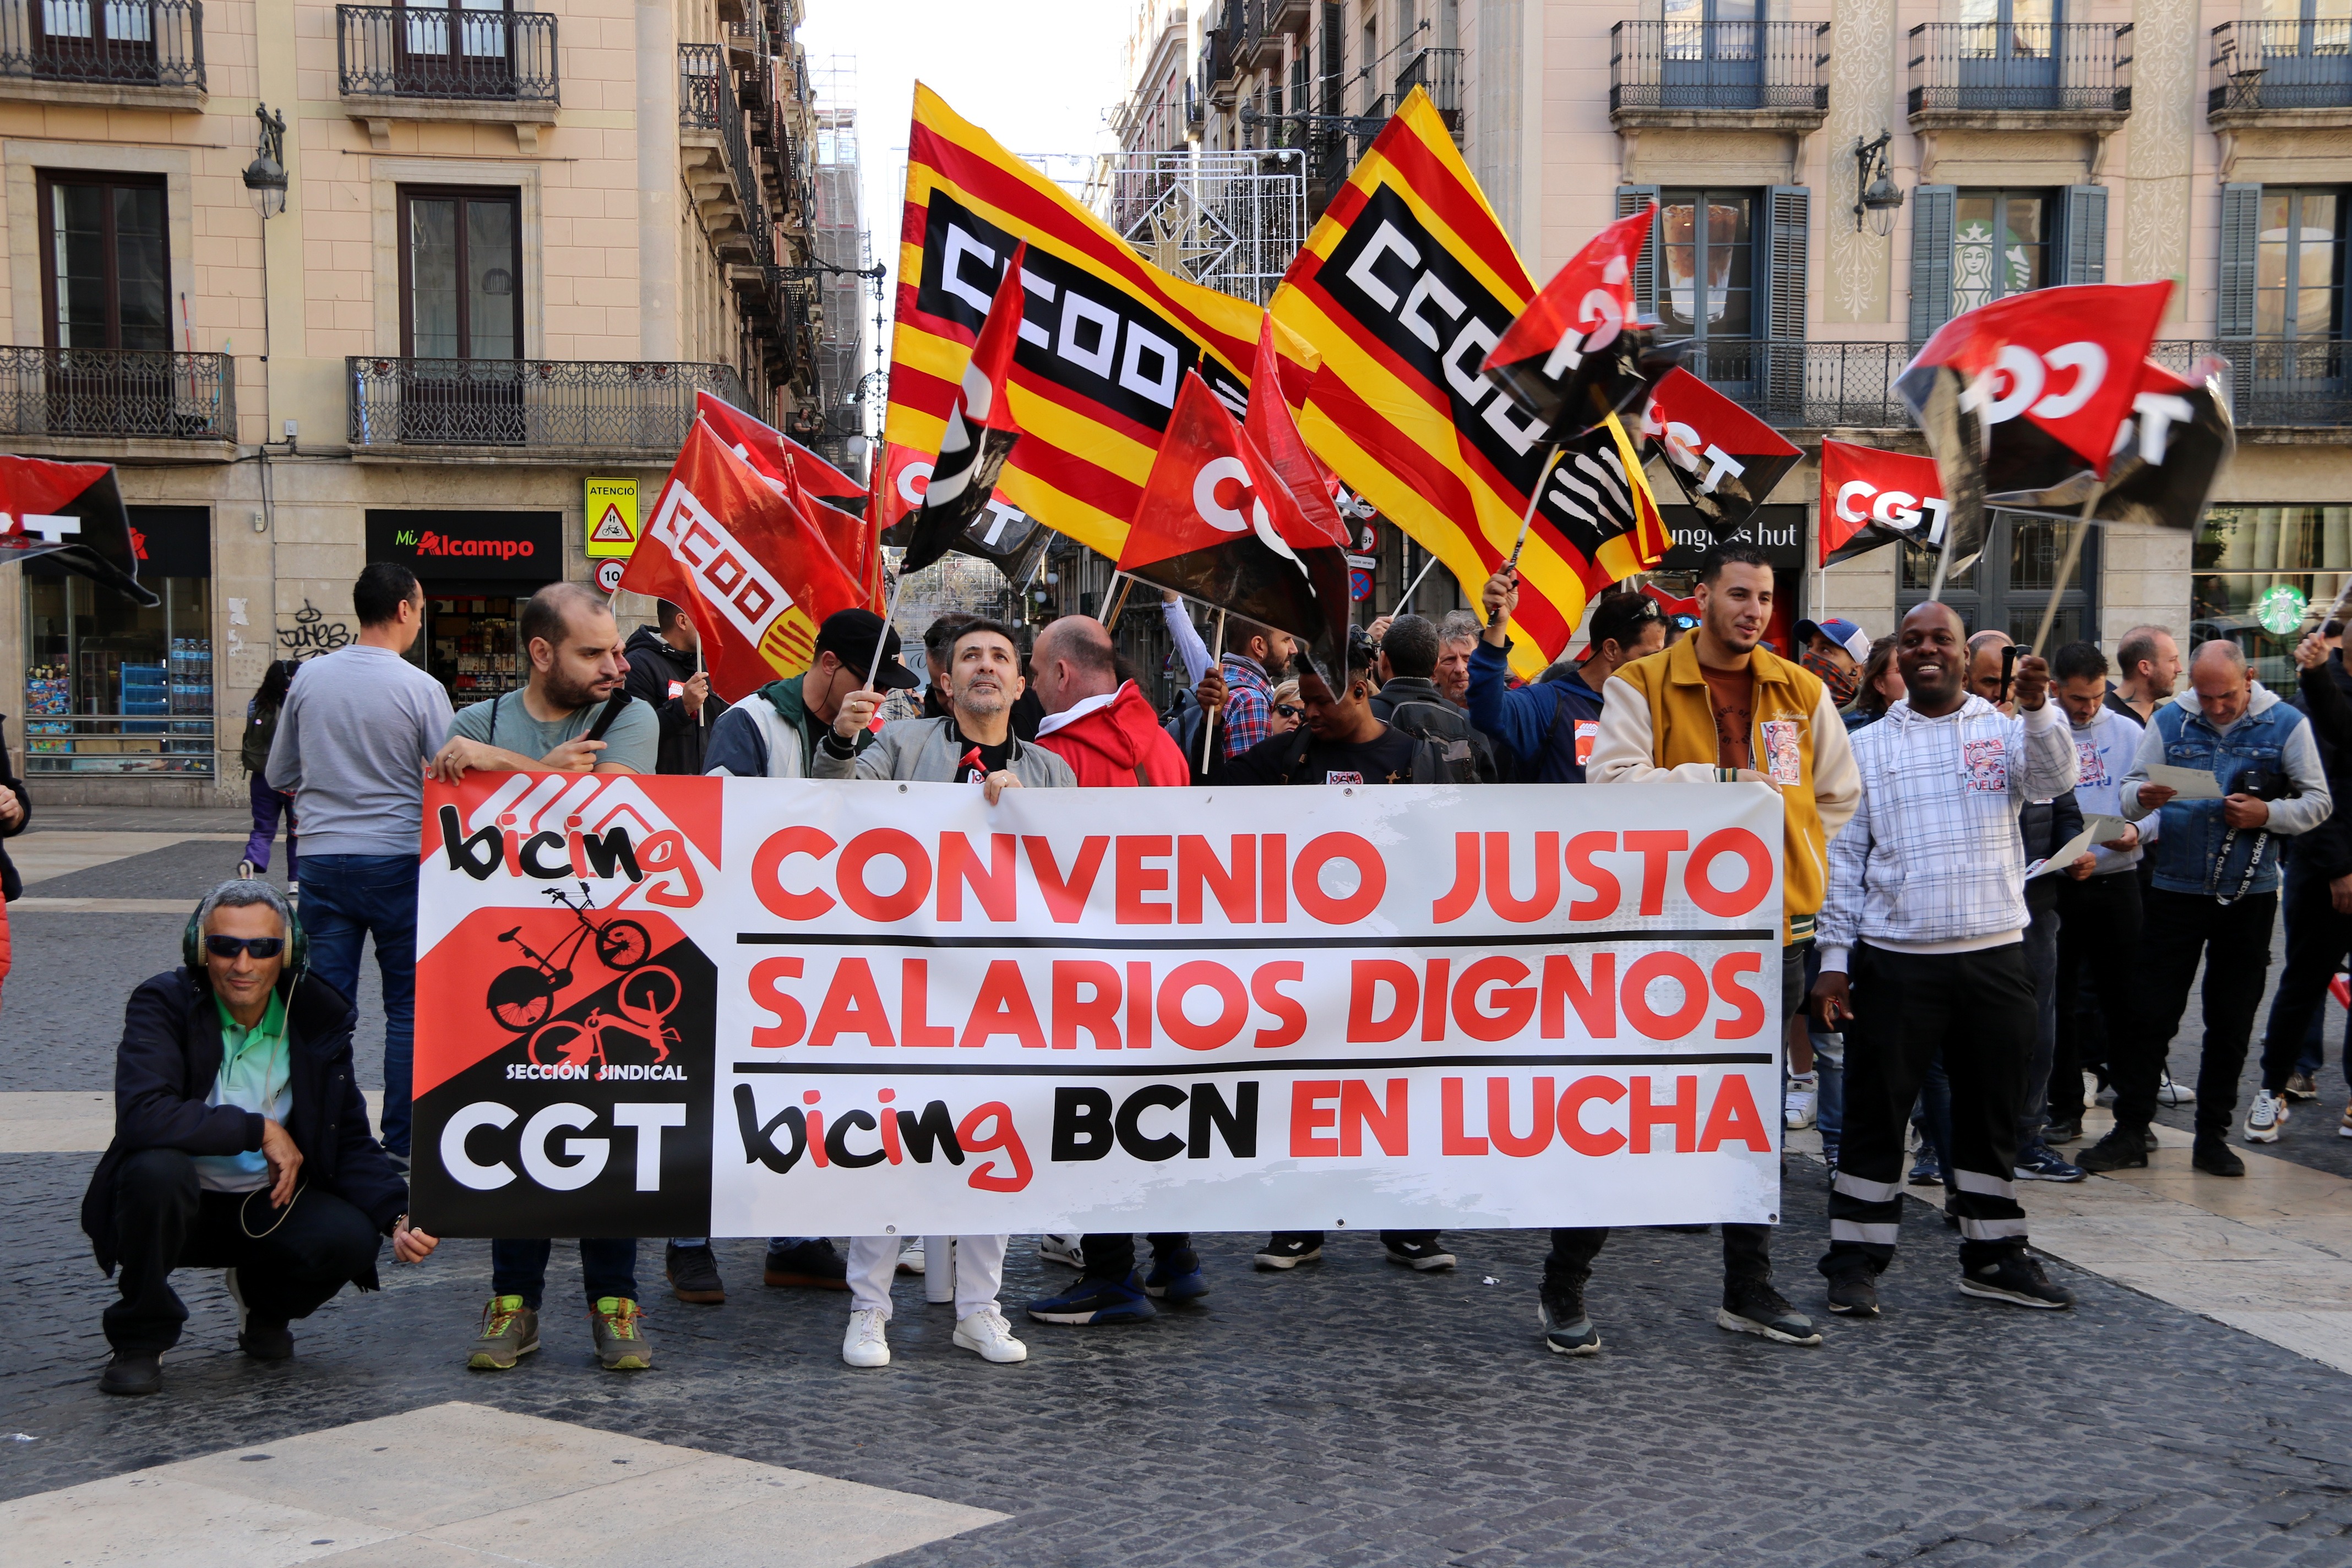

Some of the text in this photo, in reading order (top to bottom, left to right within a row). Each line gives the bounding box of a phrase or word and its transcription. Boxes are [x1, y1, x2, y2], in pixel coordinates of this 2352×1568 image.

[941, 222, 1178, 410] CCOO
[590, 486, 635, 496] ATENCIÓ
[897, 461, 1026, 546] CT
[1836, 480, 1950, 545] CGT
[395, 529, 534, 560] Mi Alcampo
[666, 498, 775, 625] CCOO
[1758, 522, 1797, 546] hut
[605, 570, 620, 581] 10
[1968, 779, 2005, 790] HUELGA
[439, 805, 704, 909] bicing
[751, 825, 1773, 925] CONVENIO JUSTO
[2251, 832, 2268, 864] adidas
[748, 951, 1766, 1051] SALARIOS DIGNOS
[507, 1060, 688, 1081] SECCIÓN SINDICAL
[440, 1102, 687, 1192] CGT
[733, 1074, 1771, 1193] bicing BCN EN LUCHA
